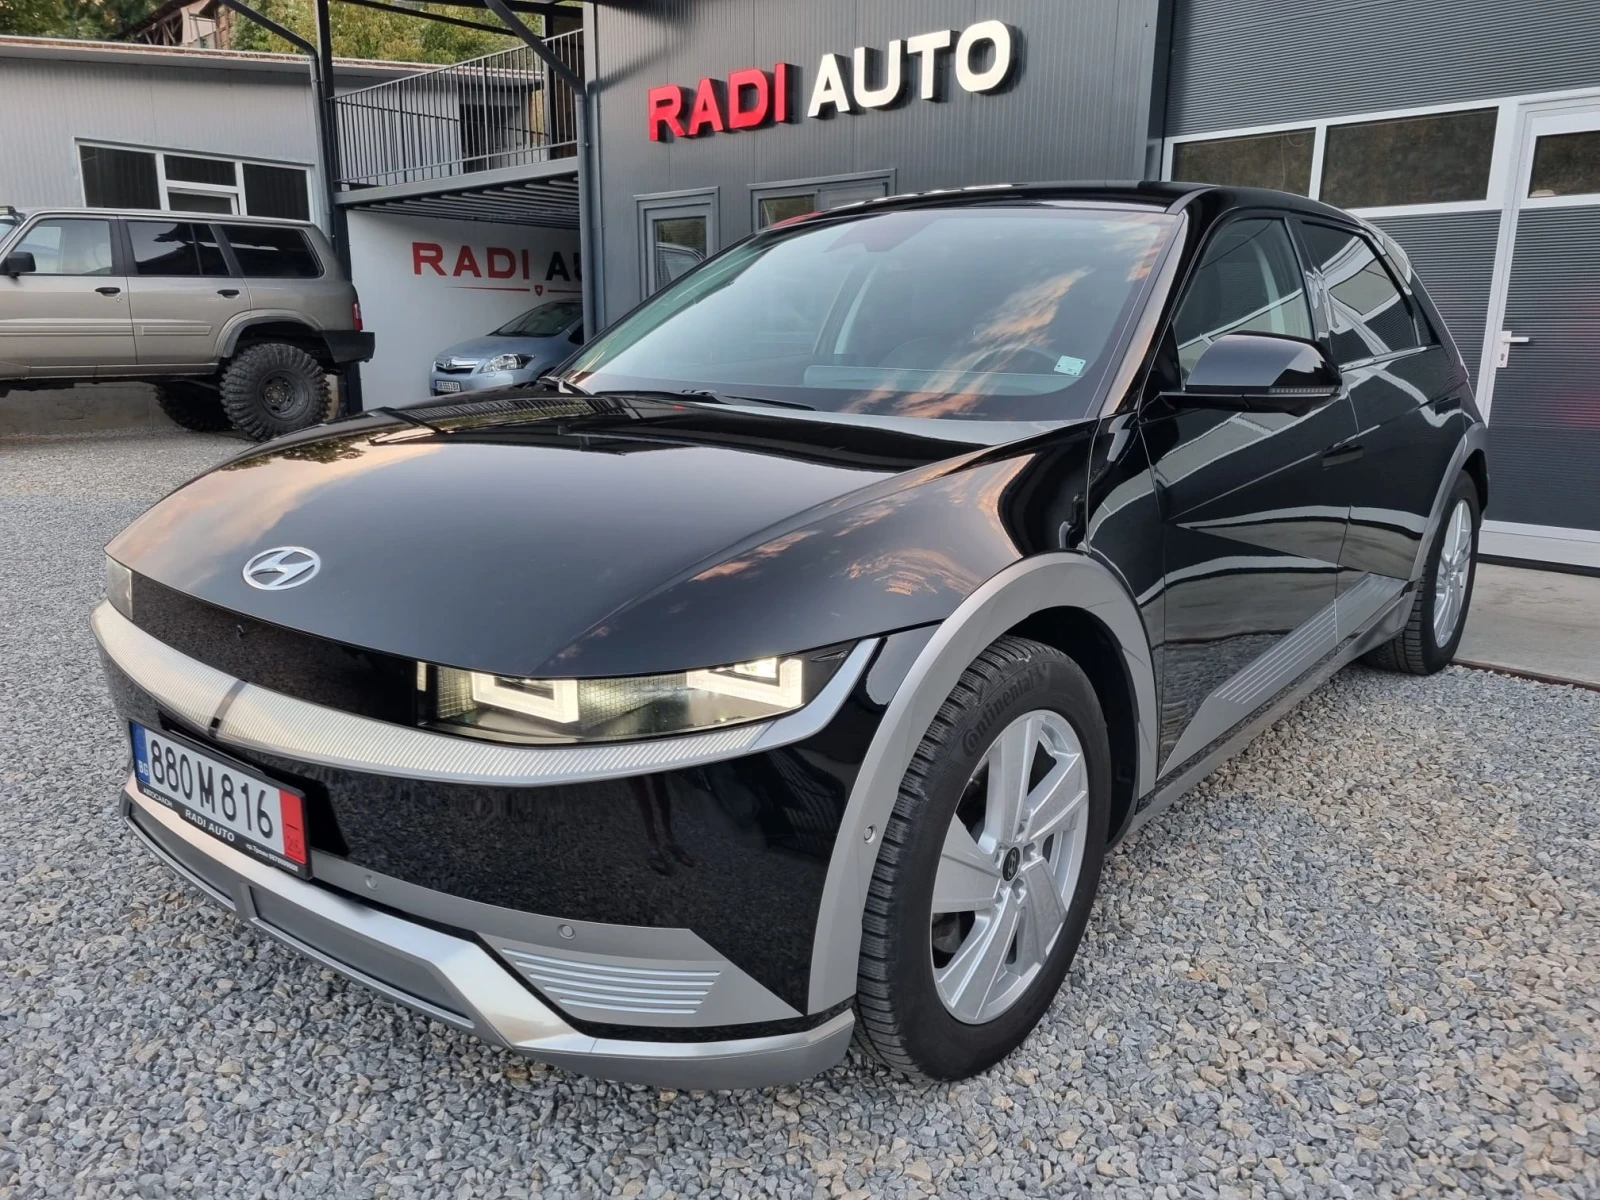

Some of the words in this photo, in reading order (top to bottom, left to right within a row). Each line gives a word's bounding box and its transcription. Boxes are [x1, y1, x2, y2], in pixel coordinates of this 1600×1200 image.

[648, 62, 787, 142] RADI
[807, 19, 1012, 118] AUTO
[412, 241, 531, 280] RADI
[962, 667, 1038, 757] Continental
[138, 760, 149, 776] BG
[151, 739, 274, 839] 880M816
[185, 809, 206, 828] RADI
[208, 823, 235, 842] AUTO
